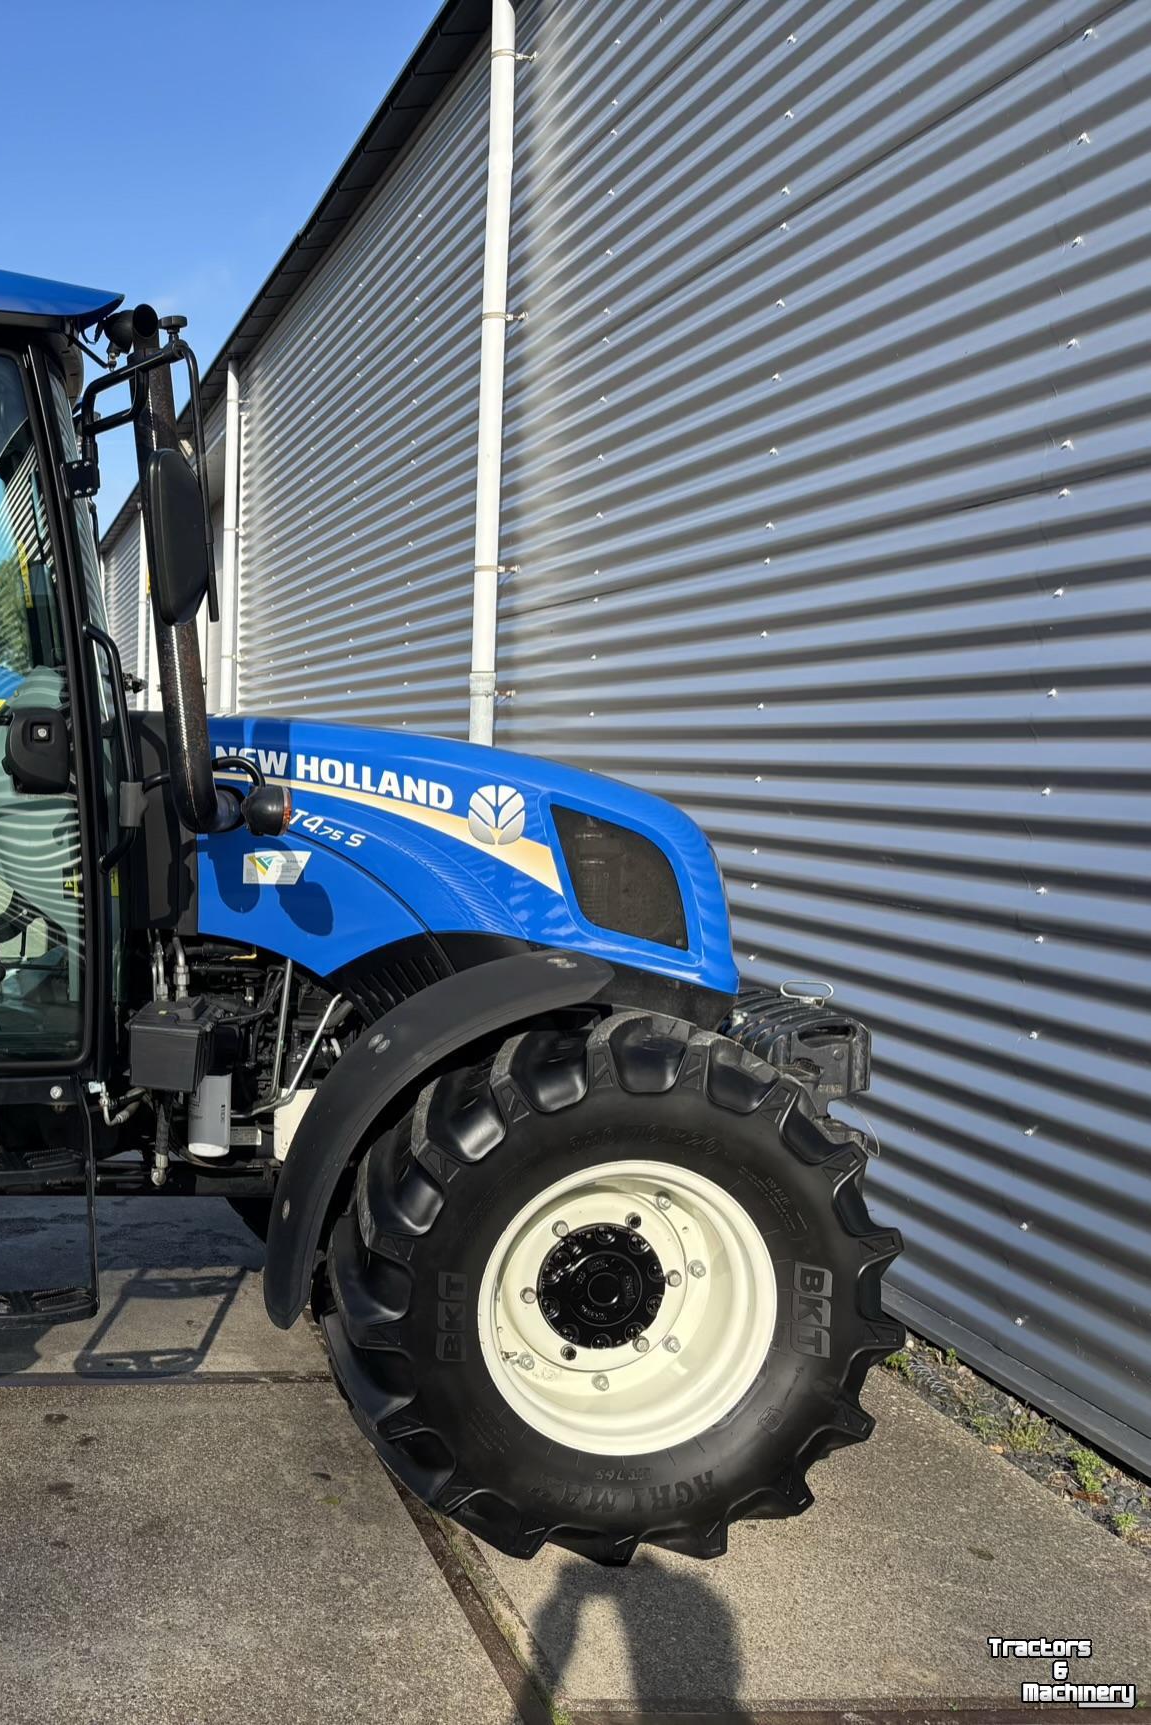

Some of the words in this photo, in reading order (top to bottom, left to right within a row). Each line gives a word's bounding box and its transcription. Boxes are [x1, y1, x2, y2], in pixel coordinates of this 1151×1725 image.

[296, 754, 454, 810] HOLLAND
[288, 808, 346, 842] T4.75
[345, 832, 366, 848] S
[440, 1273, 465, 1360] BKT
[796, 1263, 830, 1356] BKT
